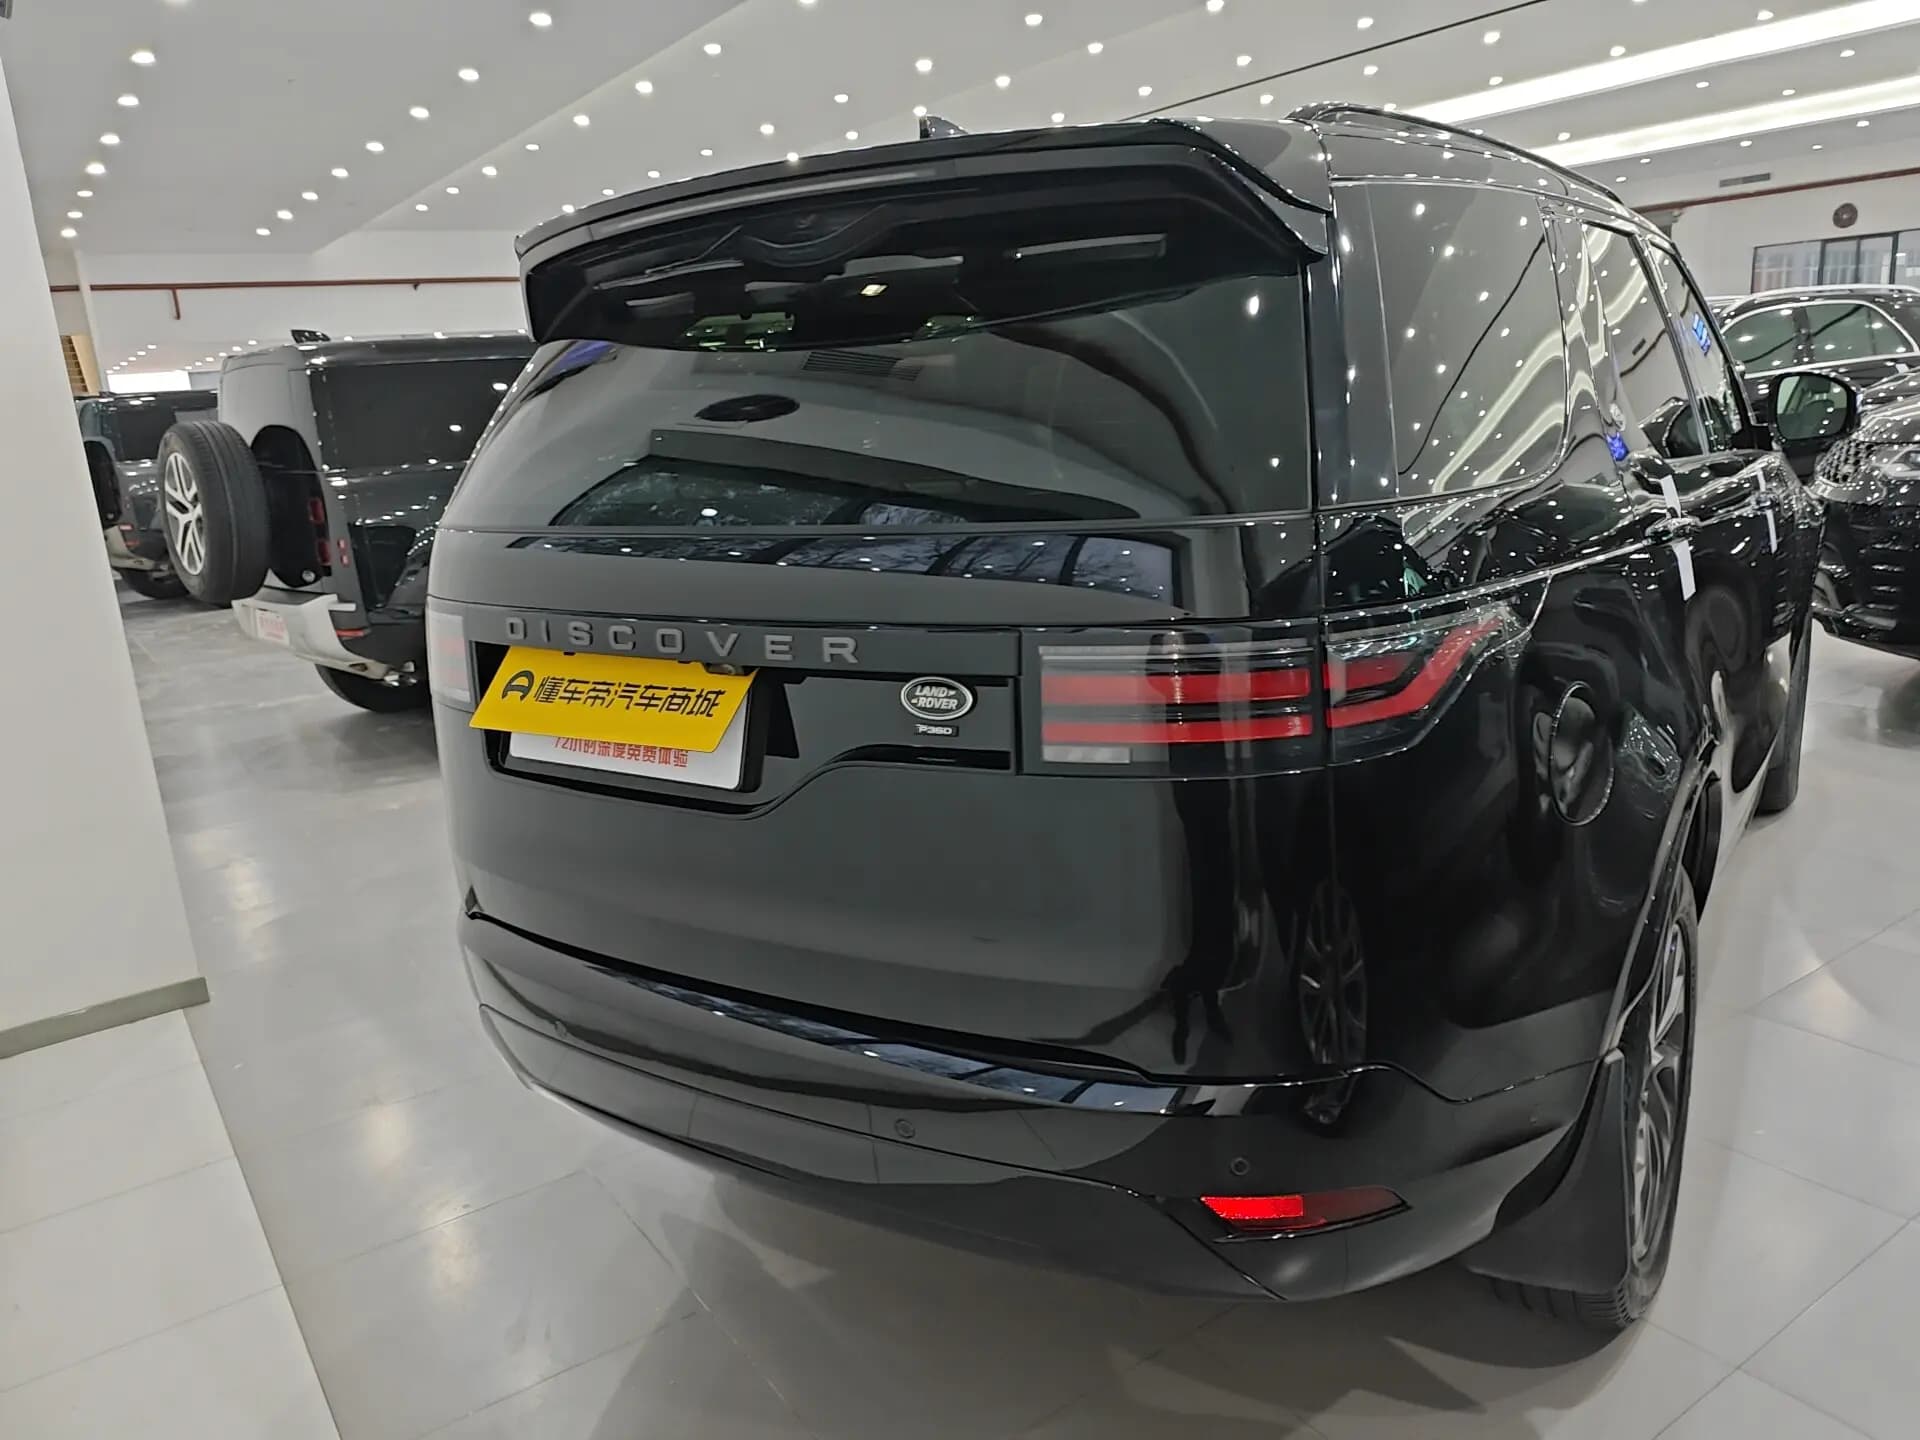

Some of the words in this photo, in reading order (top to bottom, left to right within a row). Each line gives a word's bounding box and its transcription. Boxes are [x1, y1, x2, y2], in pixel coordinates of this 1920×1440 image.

[505, 617, 859, 664] DISCOVER
[534, 675, 727, 718] 懂车帝汽车商城
[915, 685, 947, 698] LAND
[917, 697, 957, 711] ROVER
